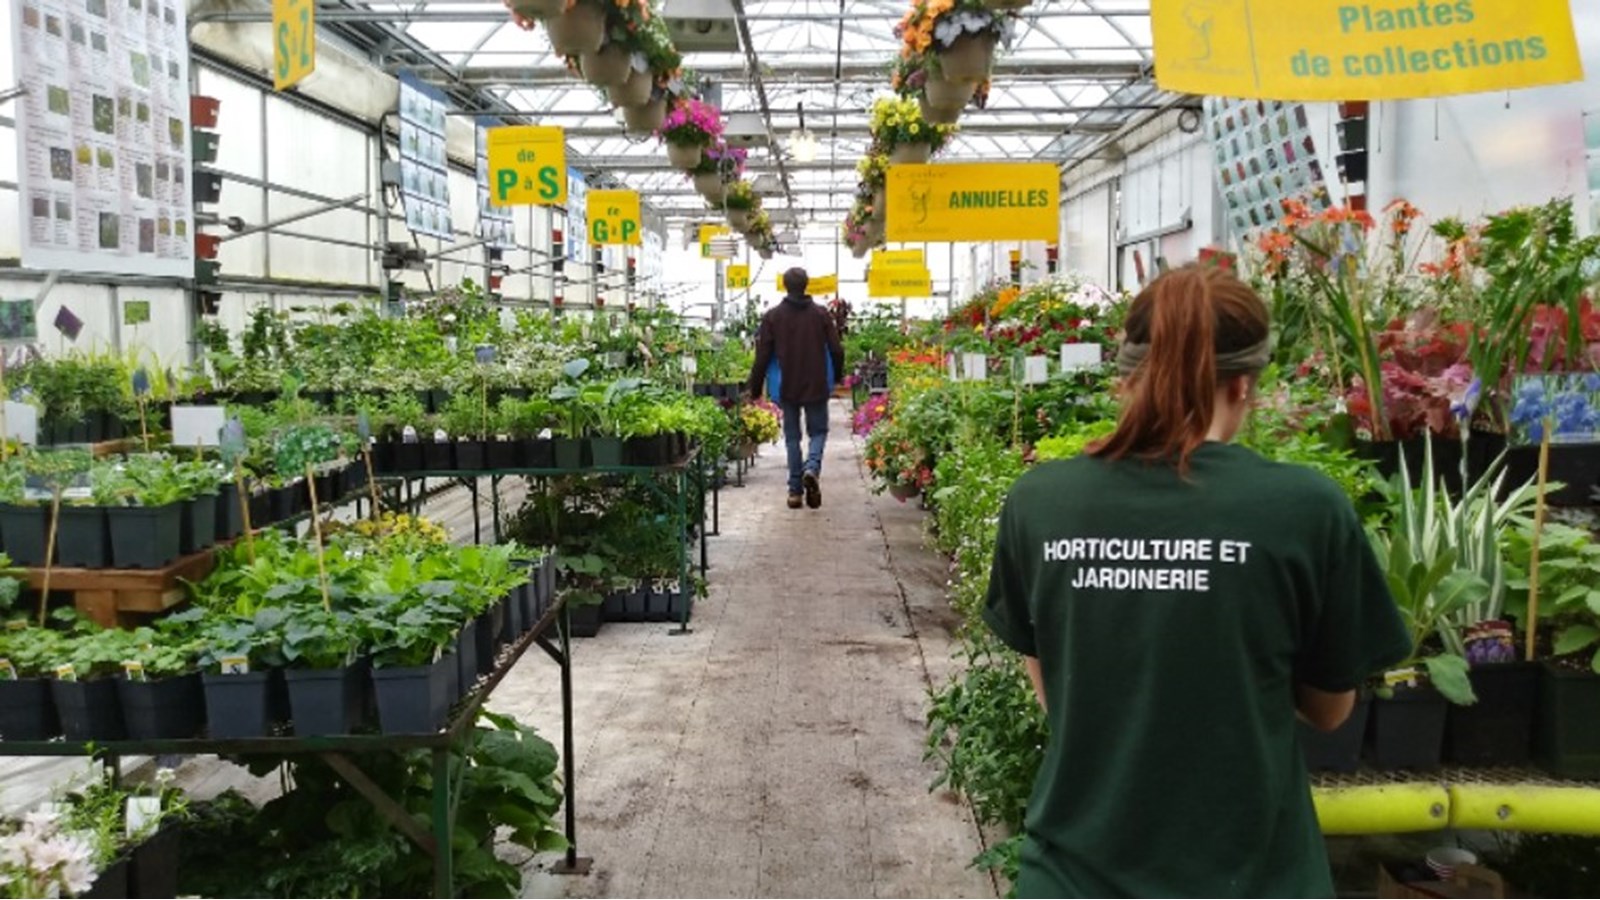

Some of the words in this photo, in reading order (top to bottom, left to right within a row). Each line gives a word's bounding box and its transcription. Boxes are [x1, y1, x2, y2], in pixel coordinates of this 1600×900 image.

[1339, 0, 1475, 33] Plantes
[279, 21, 290, 79] S
[1290, 51, 1331, 78] de
[1345, 34, 1546, 76] collections
[517, 149, 535, 162] de
[498, 169, 518, 200] P
[538, 166, 560, 200] S
[949, 189, 1049, 209] ANNUELLES
[593, 218, 609, 242] G
[621, 219, 636, 242] P
[1043, 538, 1213, 562] HORTICULTURE
[1219, 540, 1252, 564] ET
[1071, 567, 1210, 591] JARDINERIE
